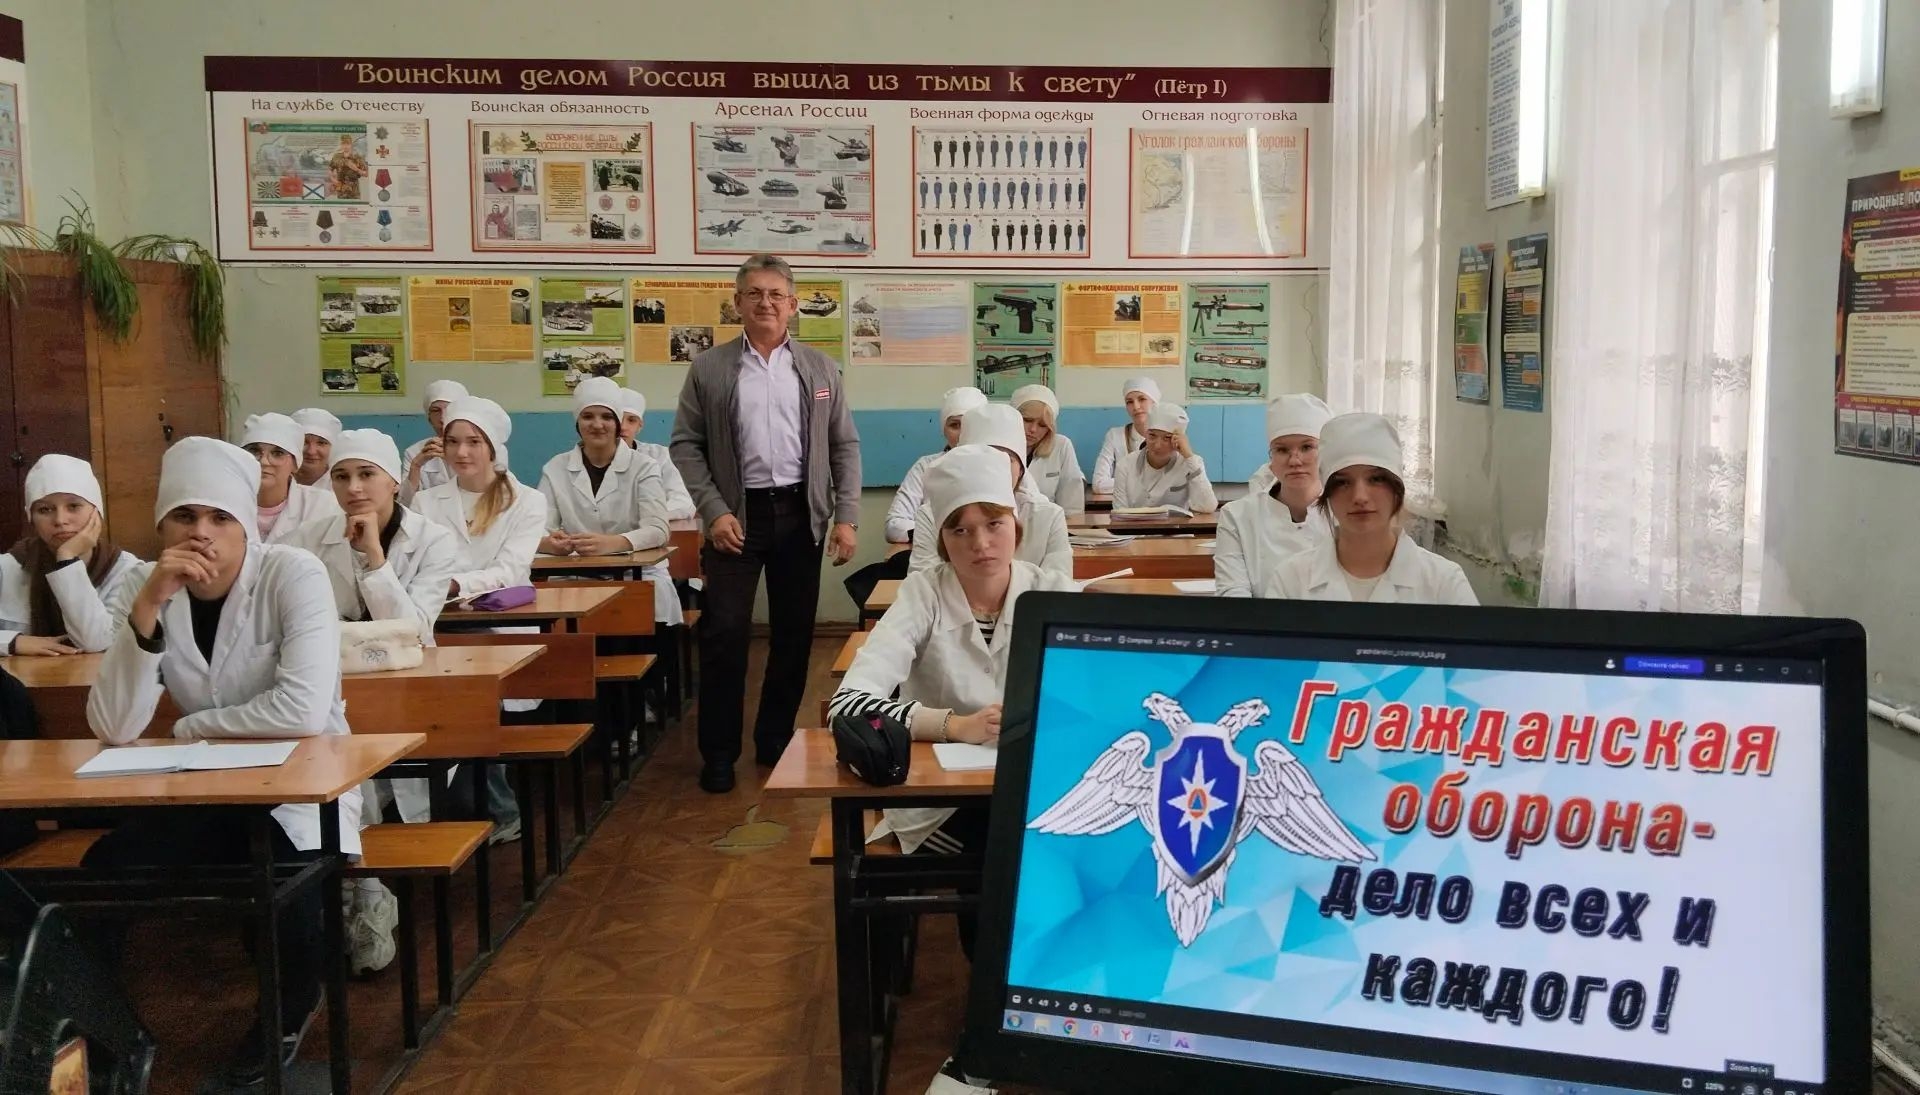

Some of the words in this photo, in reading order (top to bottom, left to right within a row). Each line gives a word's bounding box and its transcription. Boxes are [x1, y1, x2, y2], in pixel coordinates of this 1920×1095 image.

[520, 70, 609, 91] делом
[628, 66, 727, 88] Россия
[753, 71, 850, 91] вышла
[868, 74, 899, 91] из
[916, 73, 992, 92] тьмы
[1008, 72, 1025, 92] к
[1154, 79, 1209, 98] (Пётр
[251, 99, 272, 111] На
[276, 98, 335, 115] службе
[340, 100, 426, 115] Отечеству
[471, 101, 545, 113] Воинская
[550, 101, 650, 115] обязанность
[715, 102, 794, 118] Арсенал
[800, 103, 868, 118] России
[910, 107, 974, 119] Военная
[978, 108, 1031, 122] форма
[1035, 108, 1094, 123] одежды
[1142, 109, 1205, 121] Огневая
[1210, 110, 1298, 123] подготовка
[1852, 192, 1905, 212] ПРИРОДНЫЕ
[1289, 680, 1779, 776] Гражданская
[1382, 770, 1716, 858] оборона-
[1319, 865, 1474, 924] дело
[1496, 880, 1651, 942] всех
[1673, 896, 1717, 948] и
[1361, 952, 1681, 1035] каждого!
